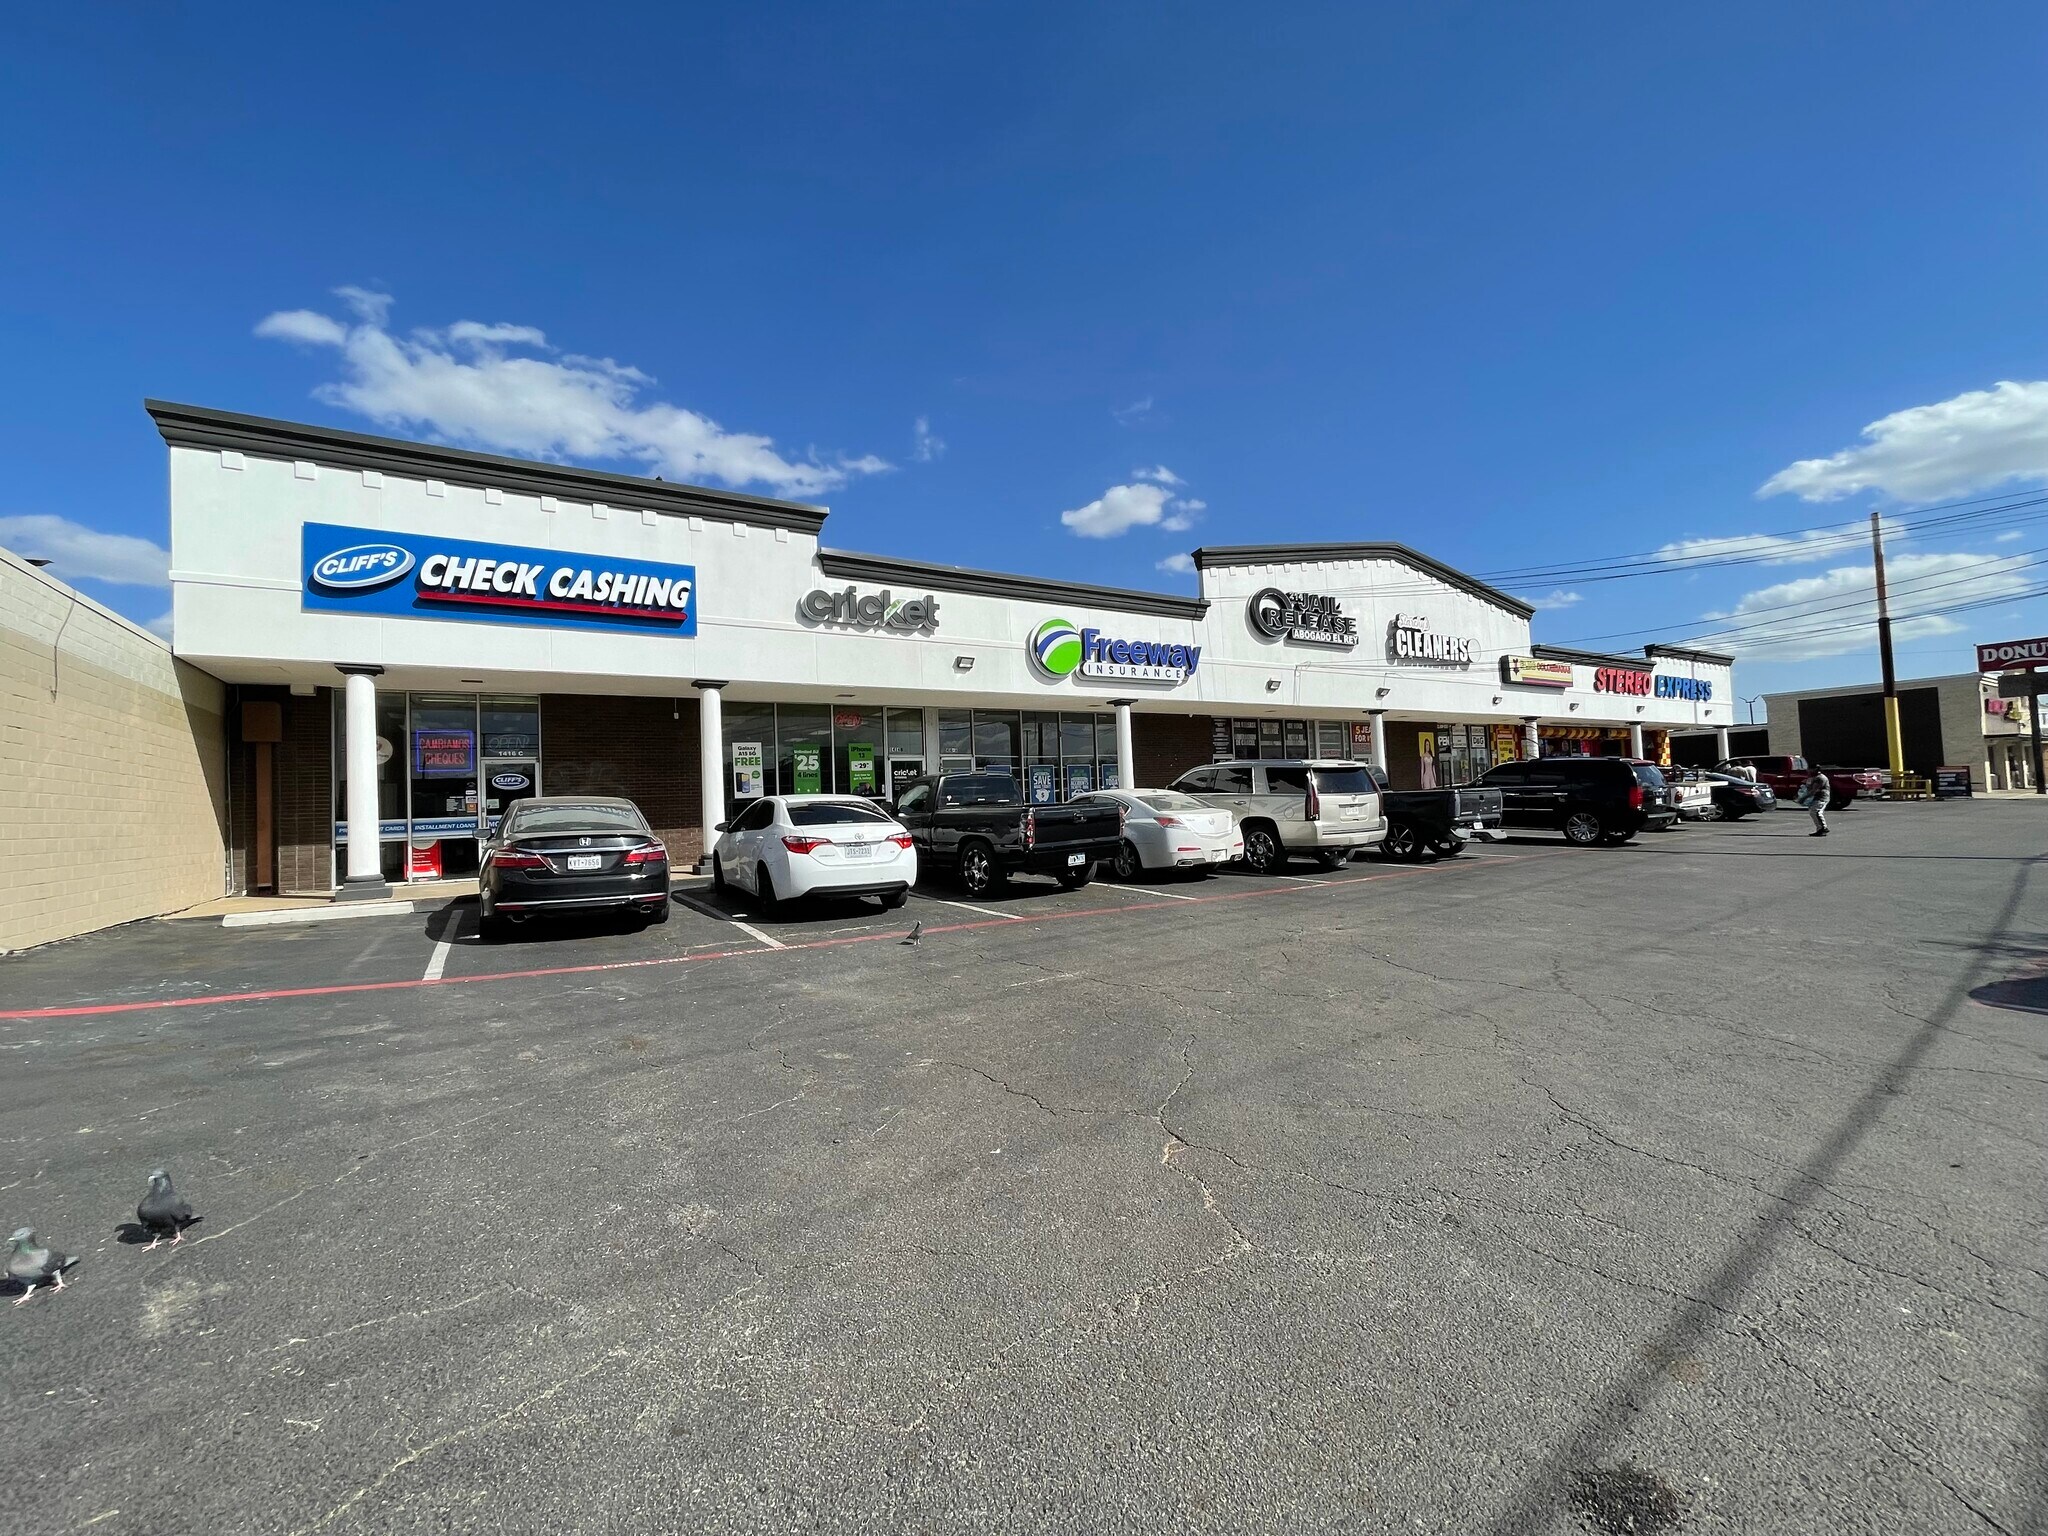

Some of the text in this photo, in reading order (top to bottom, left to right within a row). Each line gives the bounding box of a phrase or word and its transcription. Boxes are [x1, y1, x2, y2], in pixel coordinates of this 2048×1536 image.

[320, 551, 692, 608] CLIFF'S CHECK CASHING
[801, 585, 940, 627] cricket
[1298, 592, 1342, 615] JAIL
[1266, 607, 1357, 635] RELEASE
[1292, 628, 1359, 645] ABOGADO EL REY
[1395, 629, 1468, 662] CLEANERS
[1081, 628, 1202, 676] Freeway
[1982, 642, 2048, 663] DONU
[1087, 663, 1181, 679] INSURANCE
[1594, 667, 1712, 701] STEREO EXPRESS
[1355, 734, 1366, 742] FOR
[425, 753, 465, 765] CHEQUES
[734, 757, 761, 766] FREE
[893, 768, 918, 776] cricket
[1033, 775, 1051, 786] SAVE
[414, 823, 456, 831] INSTALLMENT
